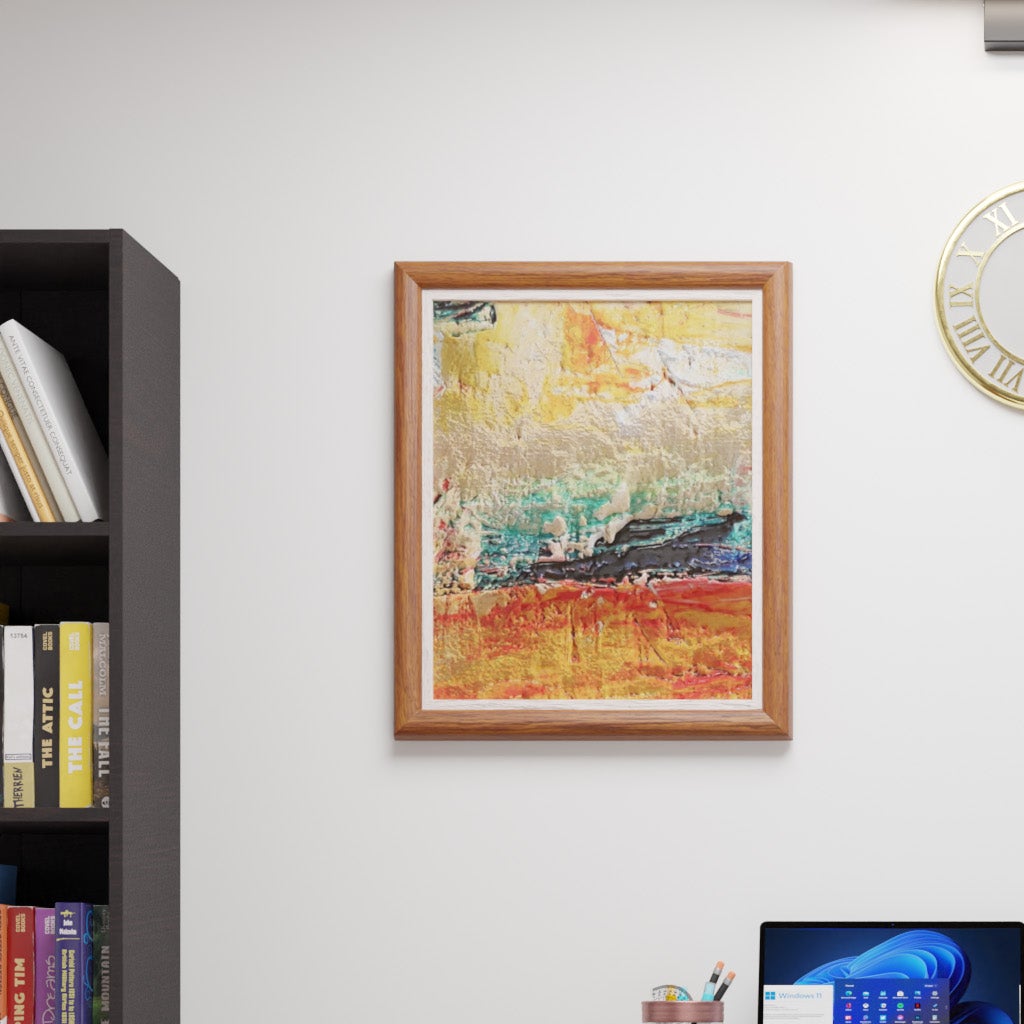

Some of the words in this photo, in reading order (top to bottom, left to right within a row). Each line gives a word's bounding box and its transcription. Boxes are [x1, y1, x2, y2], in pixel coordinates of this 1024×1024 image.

[983, 203, 1019, 237] XI
[956, 242, 985, 267] X
[949, 283, 974, 309] IX
[953, 317, 991, 363] VIII
[988, 356, 1024, 393] VII
[8, 335, 19, 355] ANTE
[18, 356, 30, 376] VITAE
[49, 431, 72, 475] CONSEQUAT
[41, 687, 54, 734] ATTIC
[68, 680, 84, 730] CALL
[41, 739, 54, 769] THE
[68, 736, 83, 775] THE
[12, 767, 24, 808] THERRIEN
[14, 957, 26, 987] TIM
[42, 955, 55, 1024] Dreams
[100, 945, 110, 1012] MOUNTAIN
